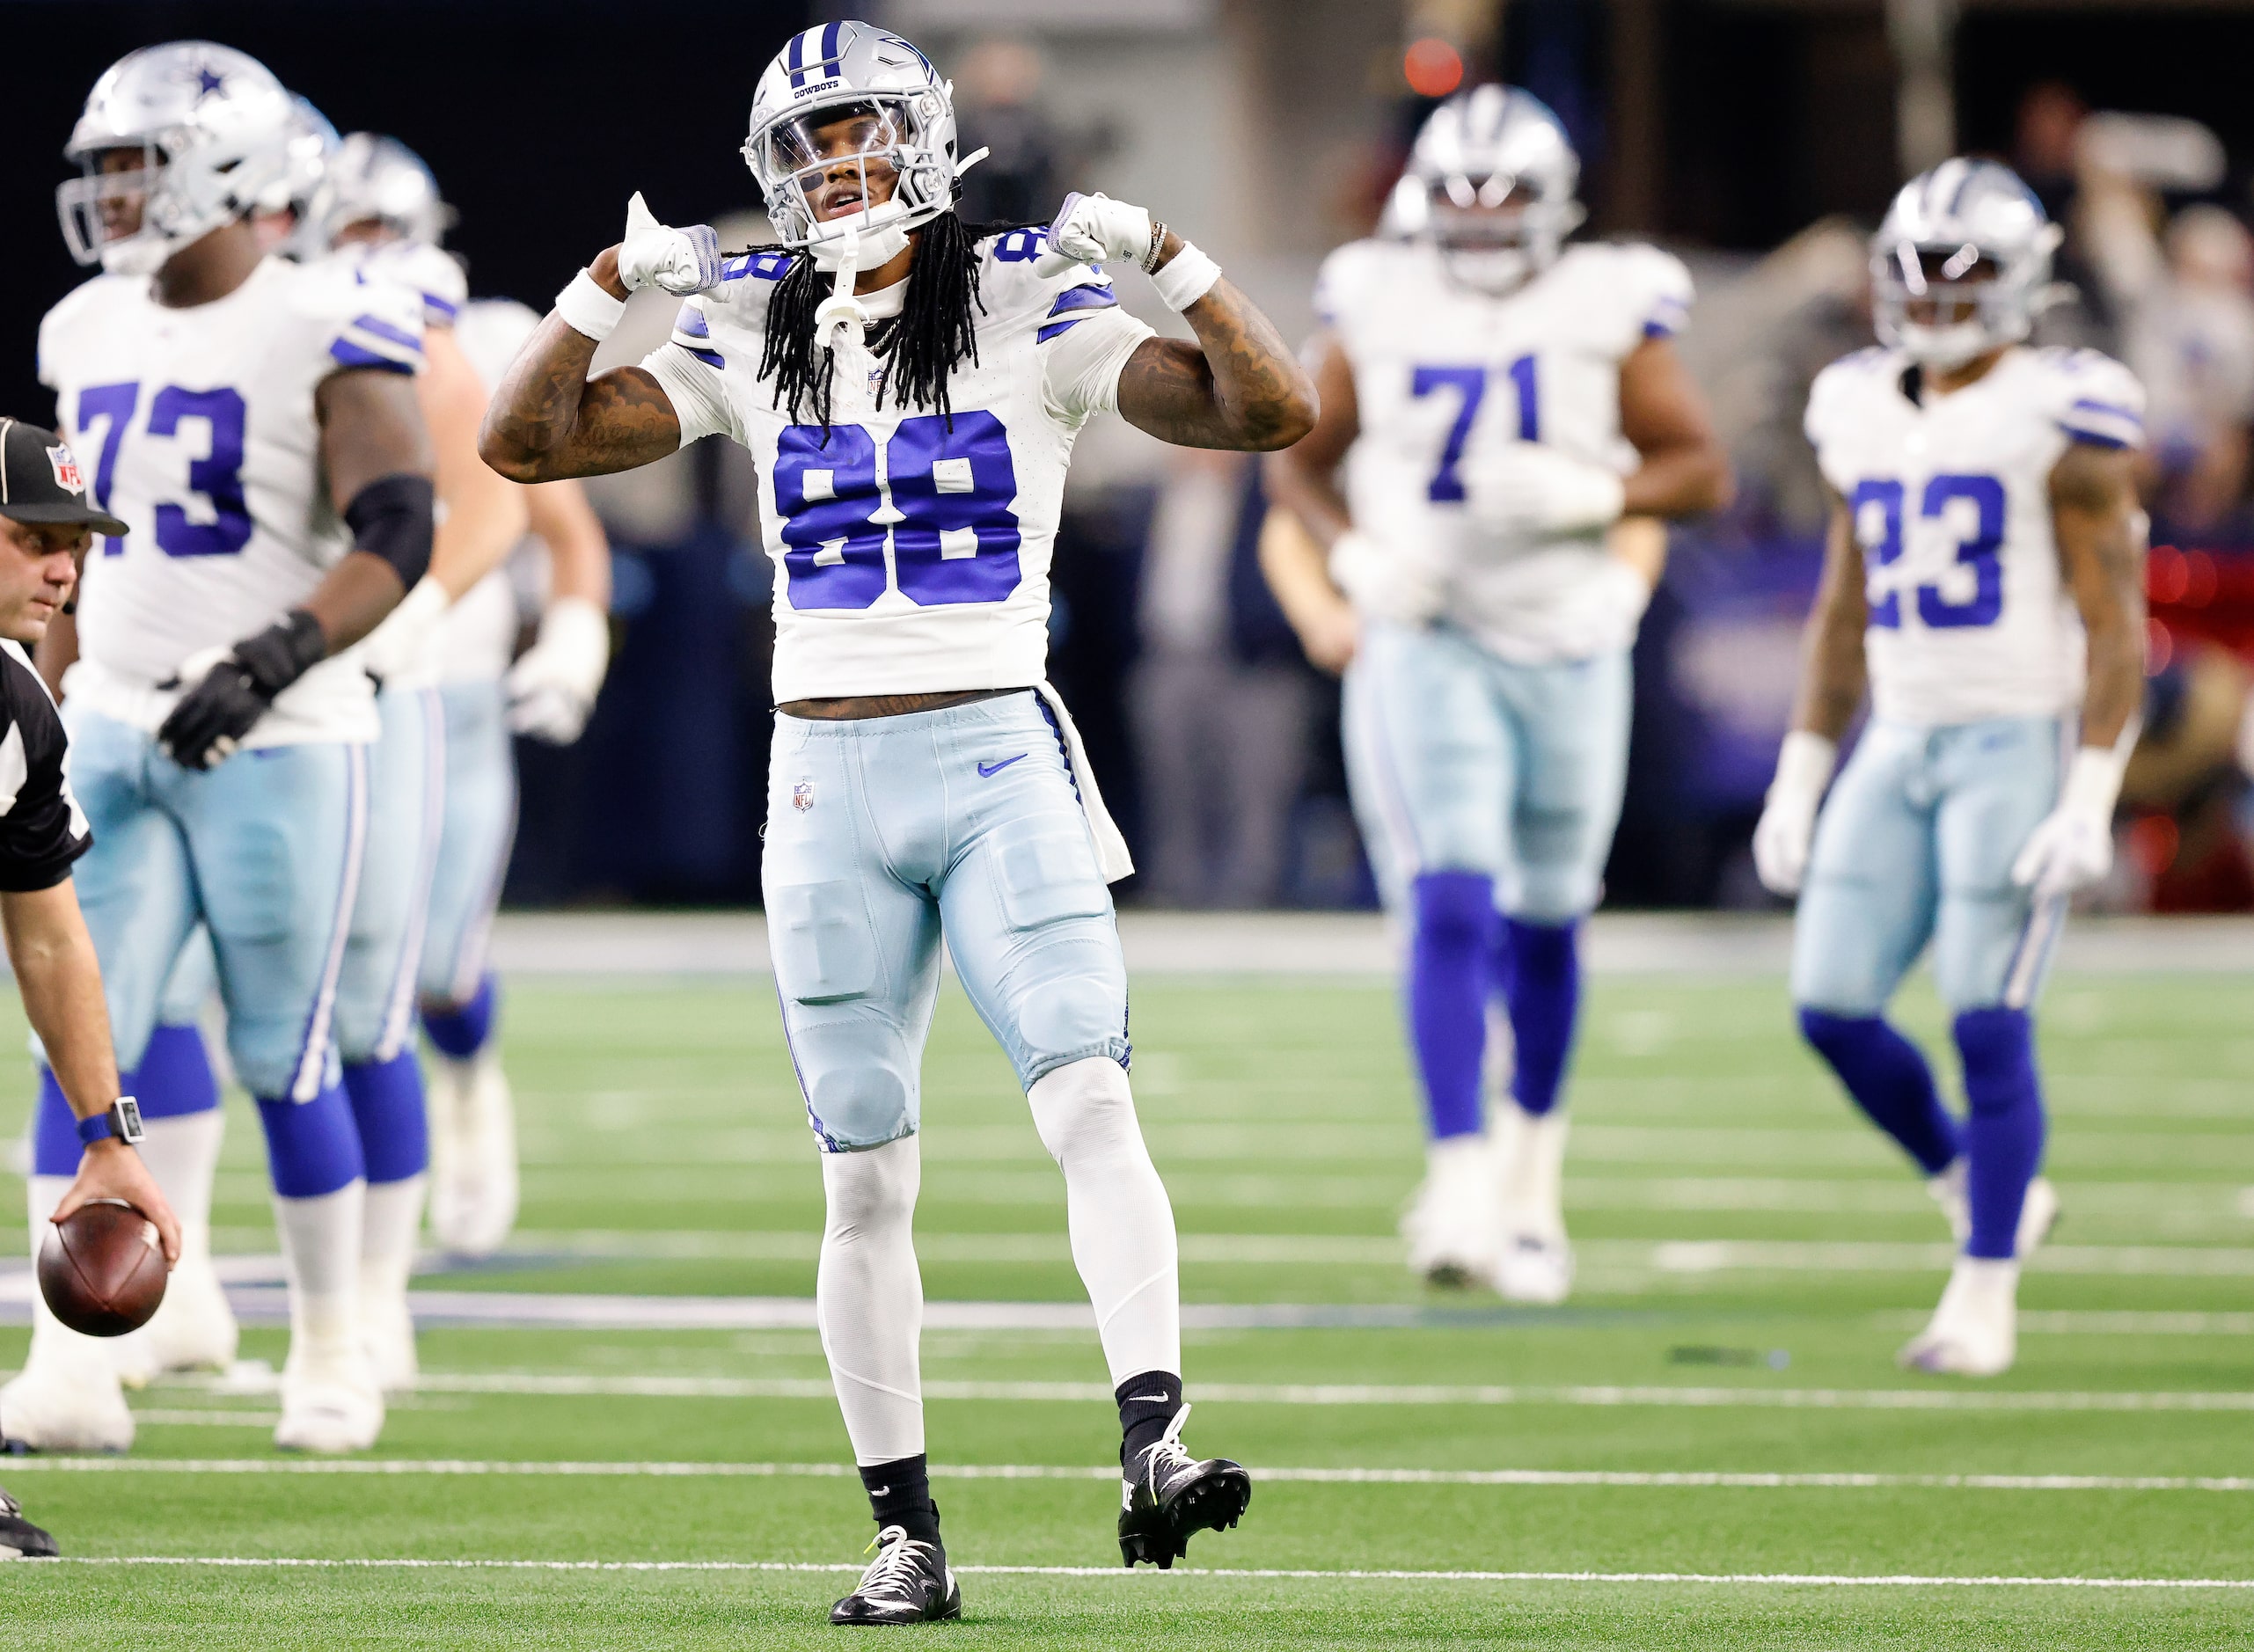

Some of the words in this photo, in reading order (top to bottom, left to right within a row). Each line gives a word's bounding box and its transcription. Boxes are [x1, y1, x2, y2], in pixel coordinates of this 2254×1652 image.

[794, 80, 839, 99] COWBOYS
[78, 382, 252, 557] 73
[1412, 355, 1538, 501] 71
[773, 410, 1021, 610] 88
[1849, 475, 2004, 630] 23
[794, 794, 809, 808] NFL
